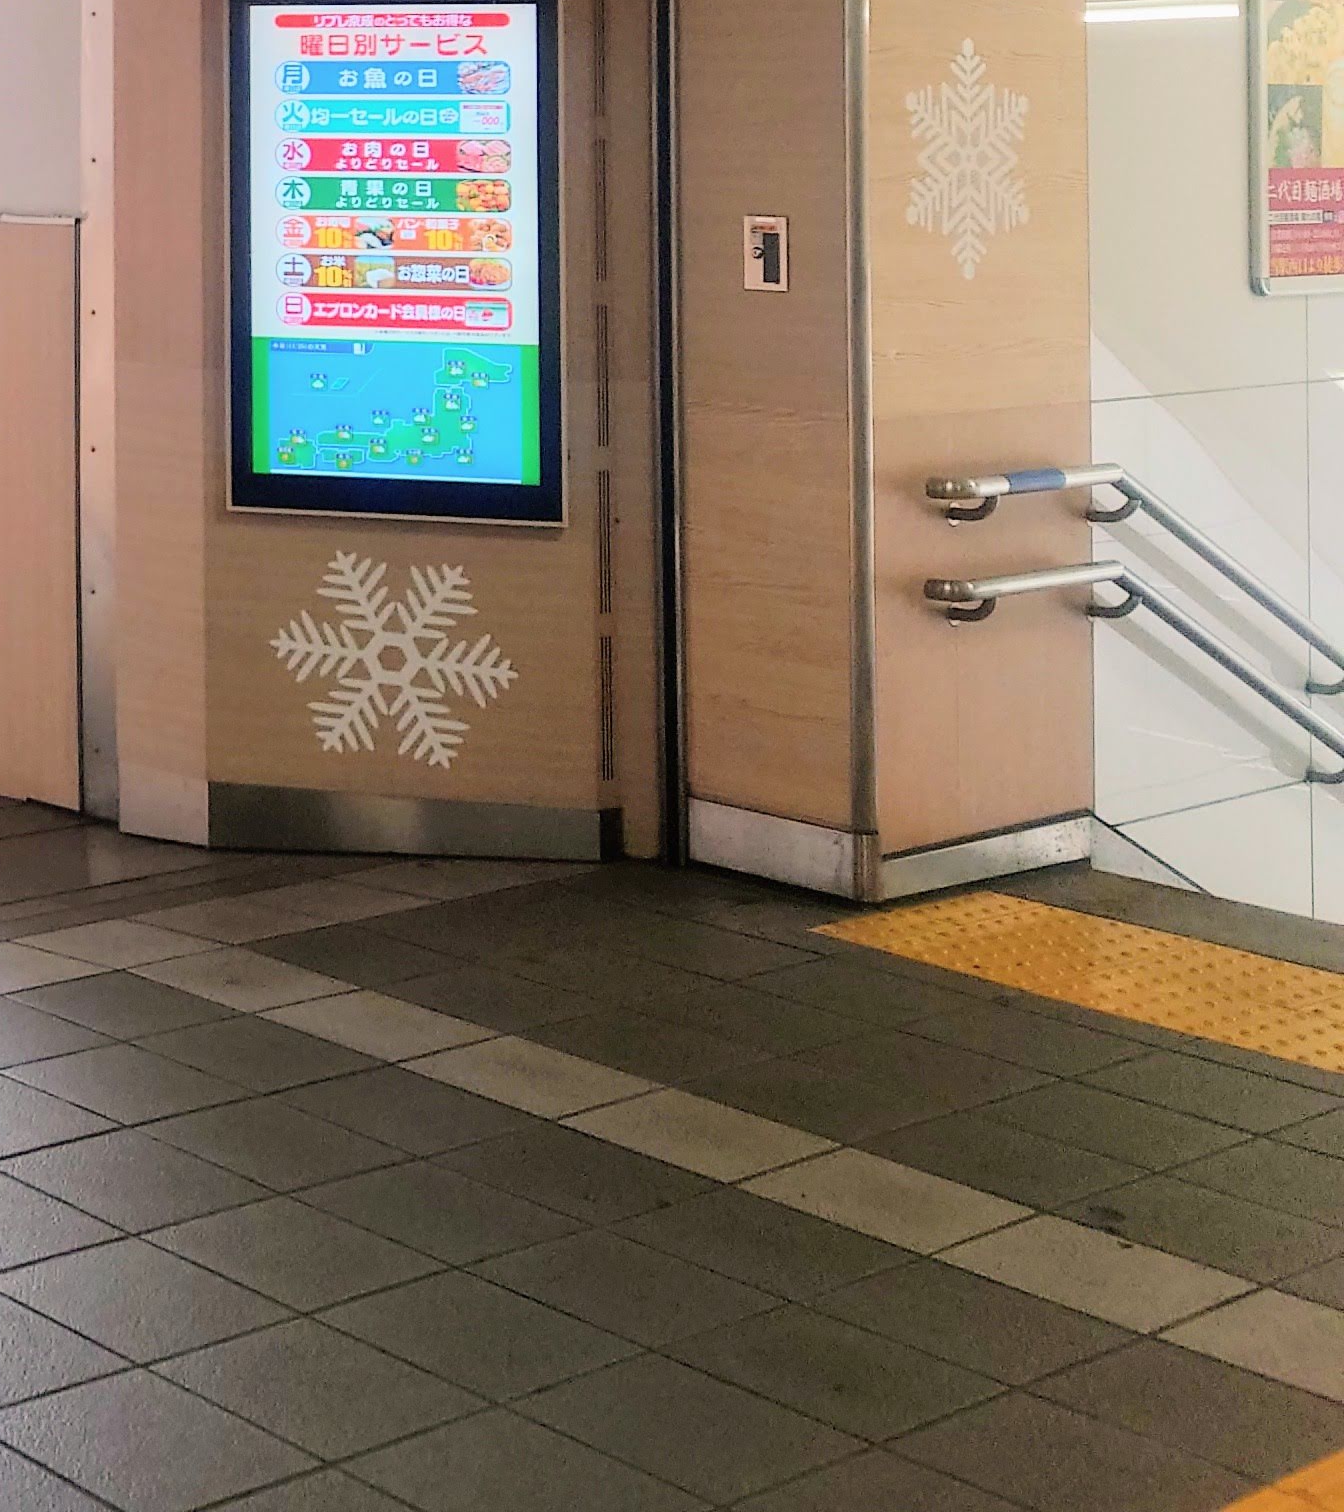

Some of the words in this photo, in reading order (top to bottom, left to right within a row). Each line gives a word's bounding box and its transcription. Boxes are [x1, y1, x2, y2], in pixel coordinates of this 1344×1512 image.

[300, 34, 488, 56] 曜日別サービス
